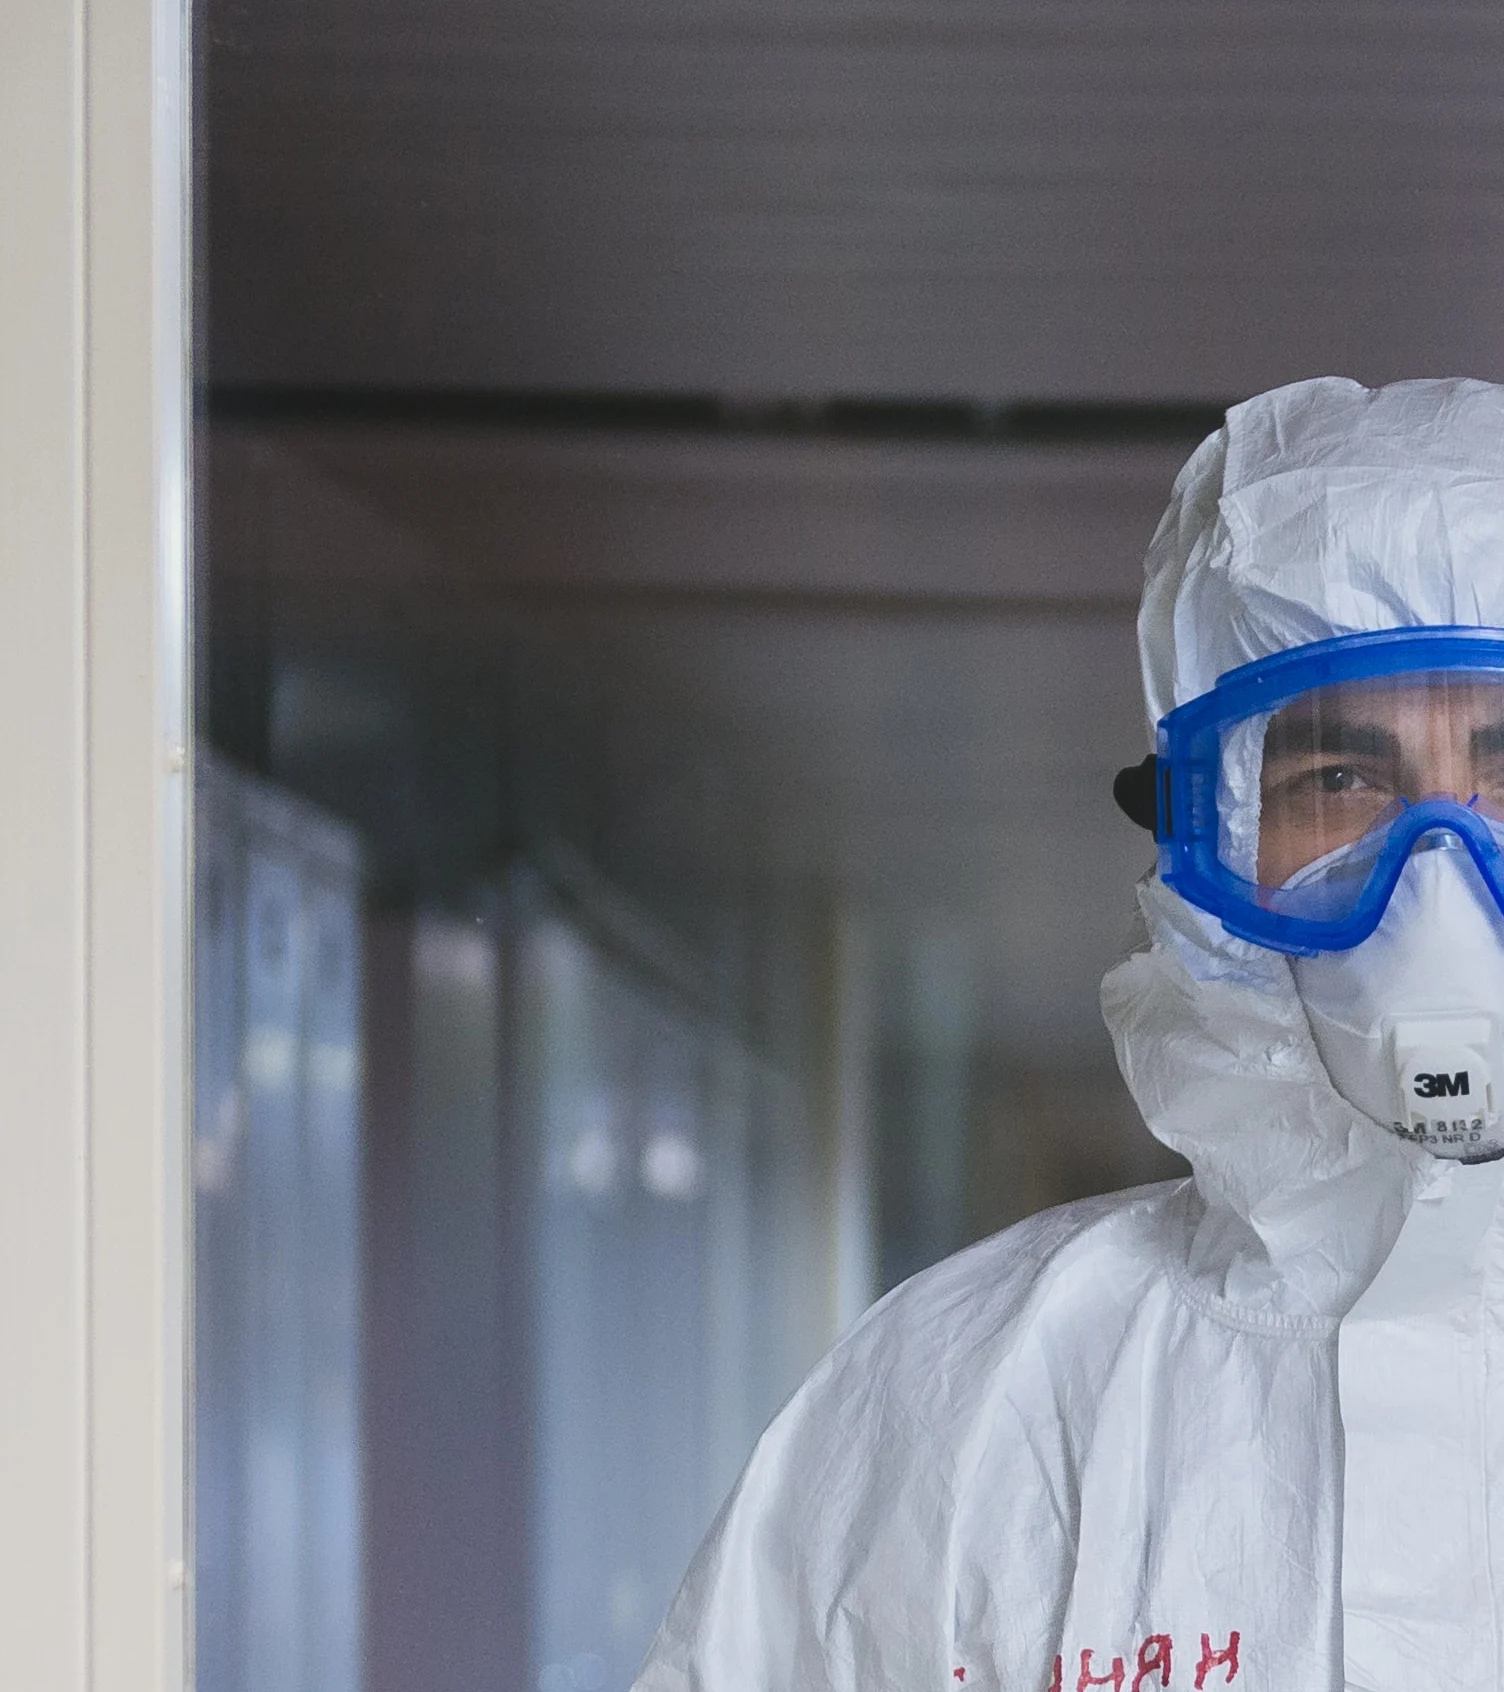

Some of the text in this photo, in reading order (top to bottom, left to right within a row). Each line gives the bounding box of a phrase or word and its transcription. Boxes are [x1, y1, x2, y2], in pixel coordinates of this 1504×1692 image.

[1413, 1071, 1470, 1098] 3M
[1441, 1134, 1463, 1143] NR
[1468, 1131, 1481, 1142] D
